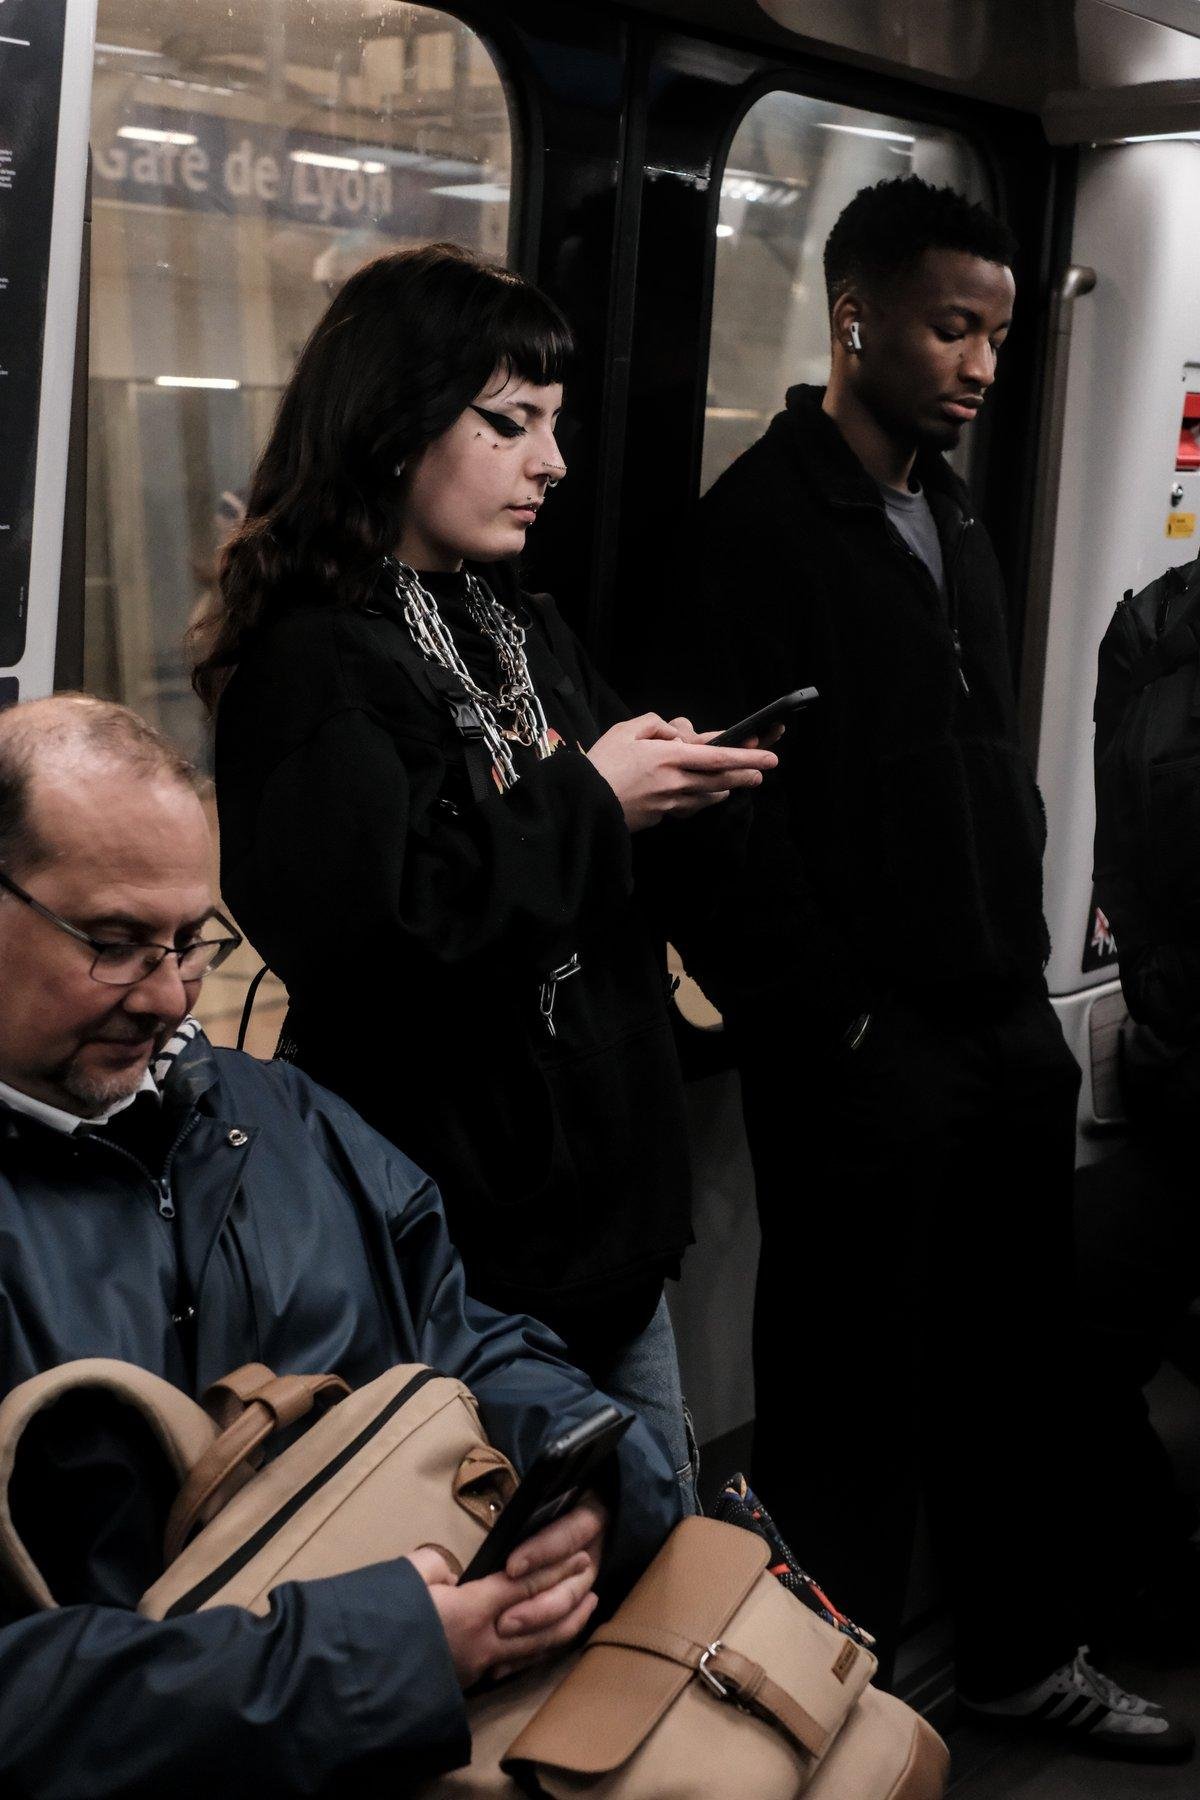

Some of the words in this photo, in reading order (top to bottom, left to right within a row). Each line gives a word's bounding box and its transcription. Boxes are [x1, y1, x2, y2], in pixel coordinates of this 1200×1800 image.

[93, 140, 210, 192] Gare
[224, 140, 280, 199] de
[292, 155, 392, 221] Lyon
